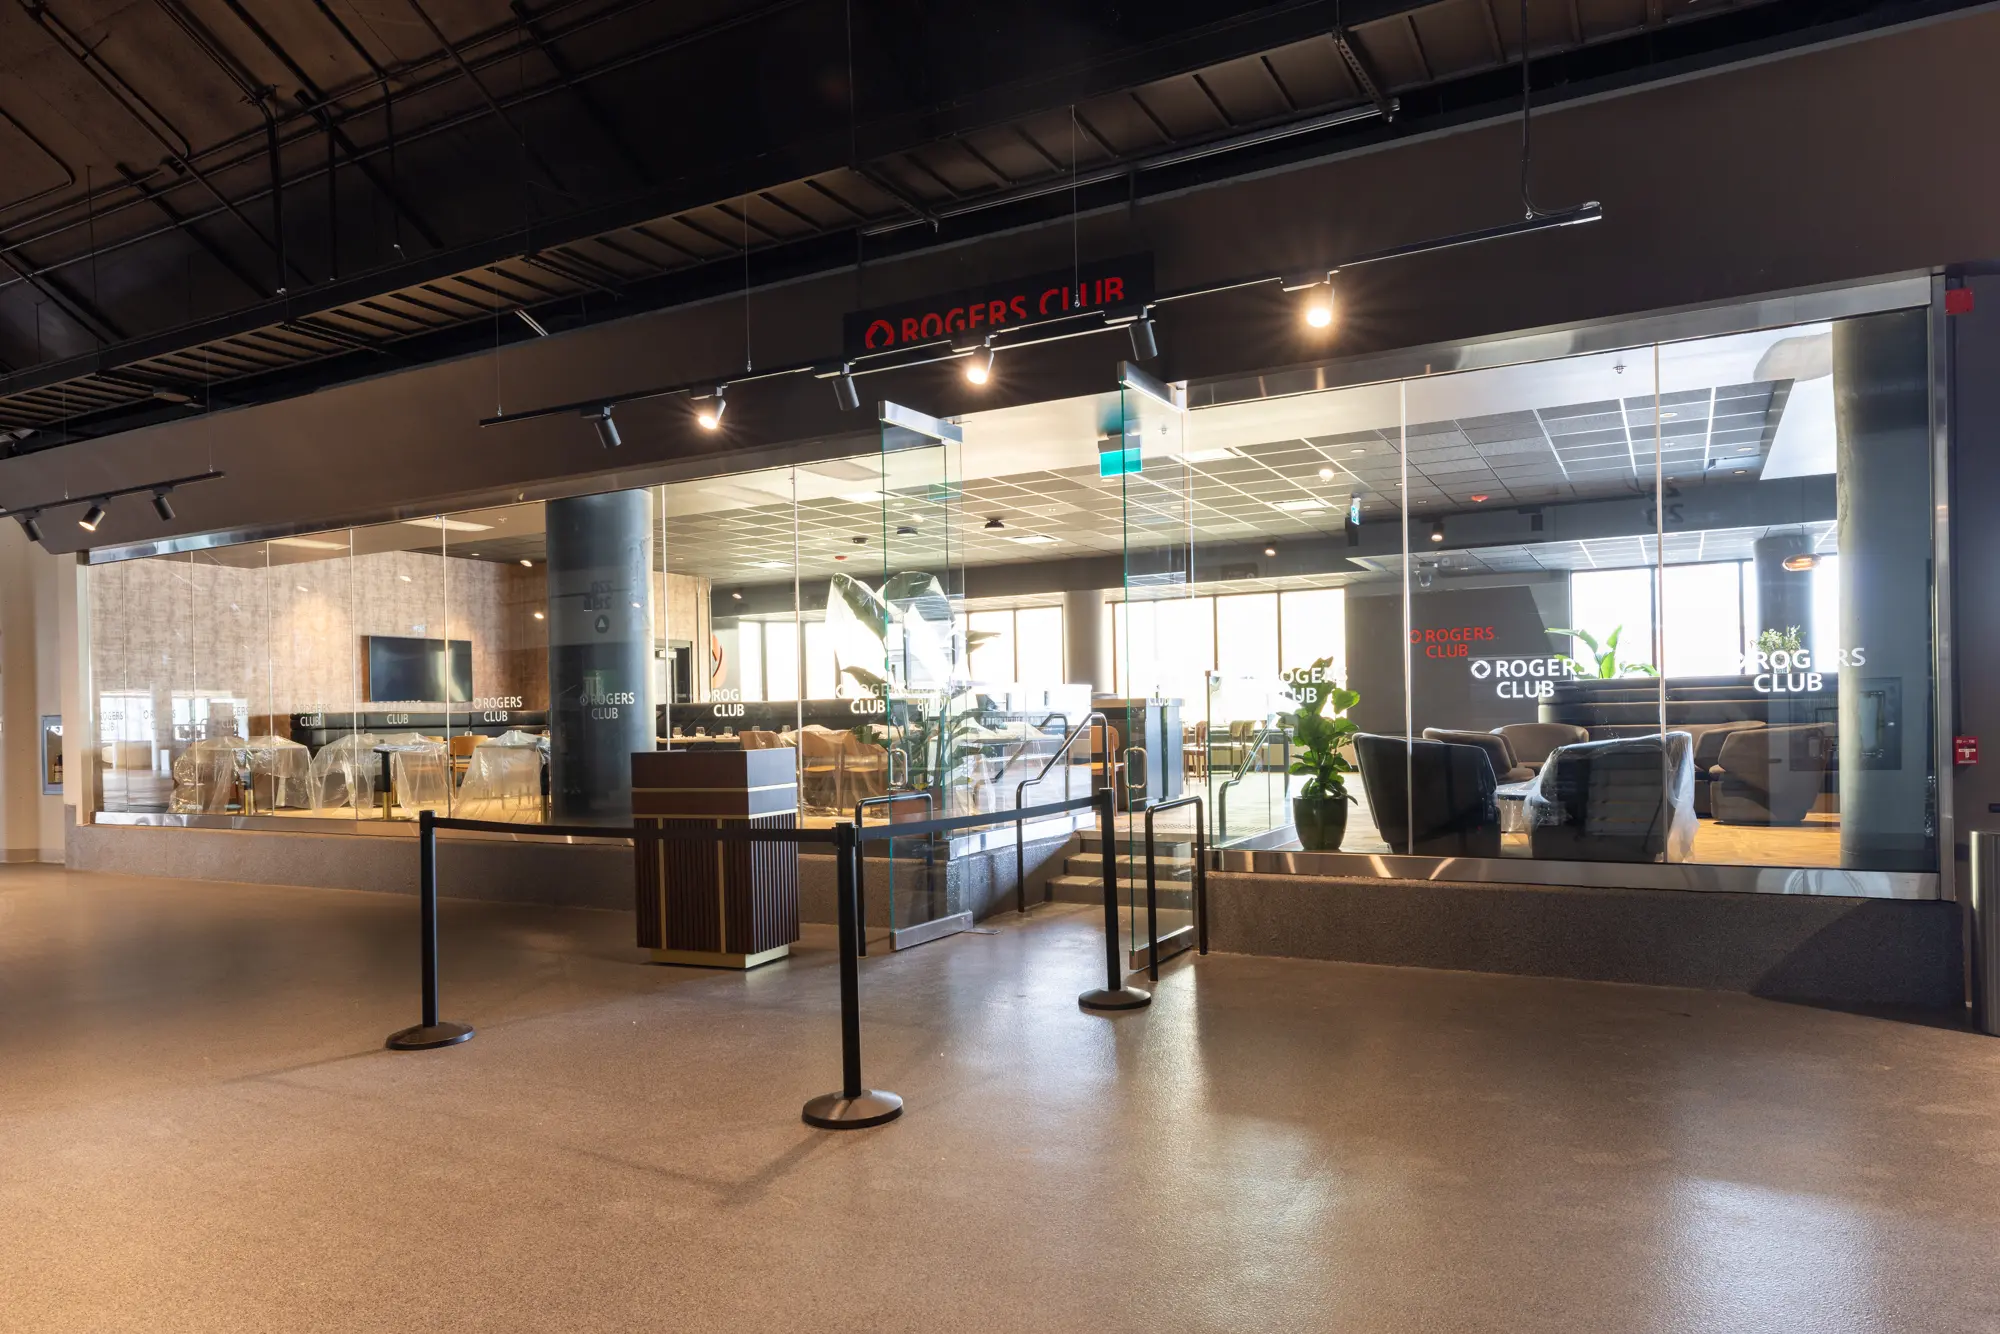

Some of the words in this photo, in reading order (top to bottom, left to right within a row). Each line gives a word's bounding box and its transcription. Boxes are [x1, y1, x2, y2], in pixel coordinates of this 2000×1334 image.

[902, 295, 1027, 342] ROGERS
[1040, 276, 1125, 315] CLUB
[1425, 626, 1495, 643] ROGERS
[1426, 643, 1468, 659] CLUB
[1756, 648, 1867, 670] ROGRS
[1496, 680, 1555, 699] CLUB
[1753, 673, 1823, 693] CLUB
[483, 696, 523, 709] ROGERS
[591, 692, 635, 705] ROGERS
[592, 707, 619, 720] CLUB
[713, 703, 745, 717] CLUB
[850, 699, 886, 714] CLUB
[300, 716, 322, 729] CLUB
[386, 713, 409, 725] CLUB
[484, 710, 508, 722] CLUB
